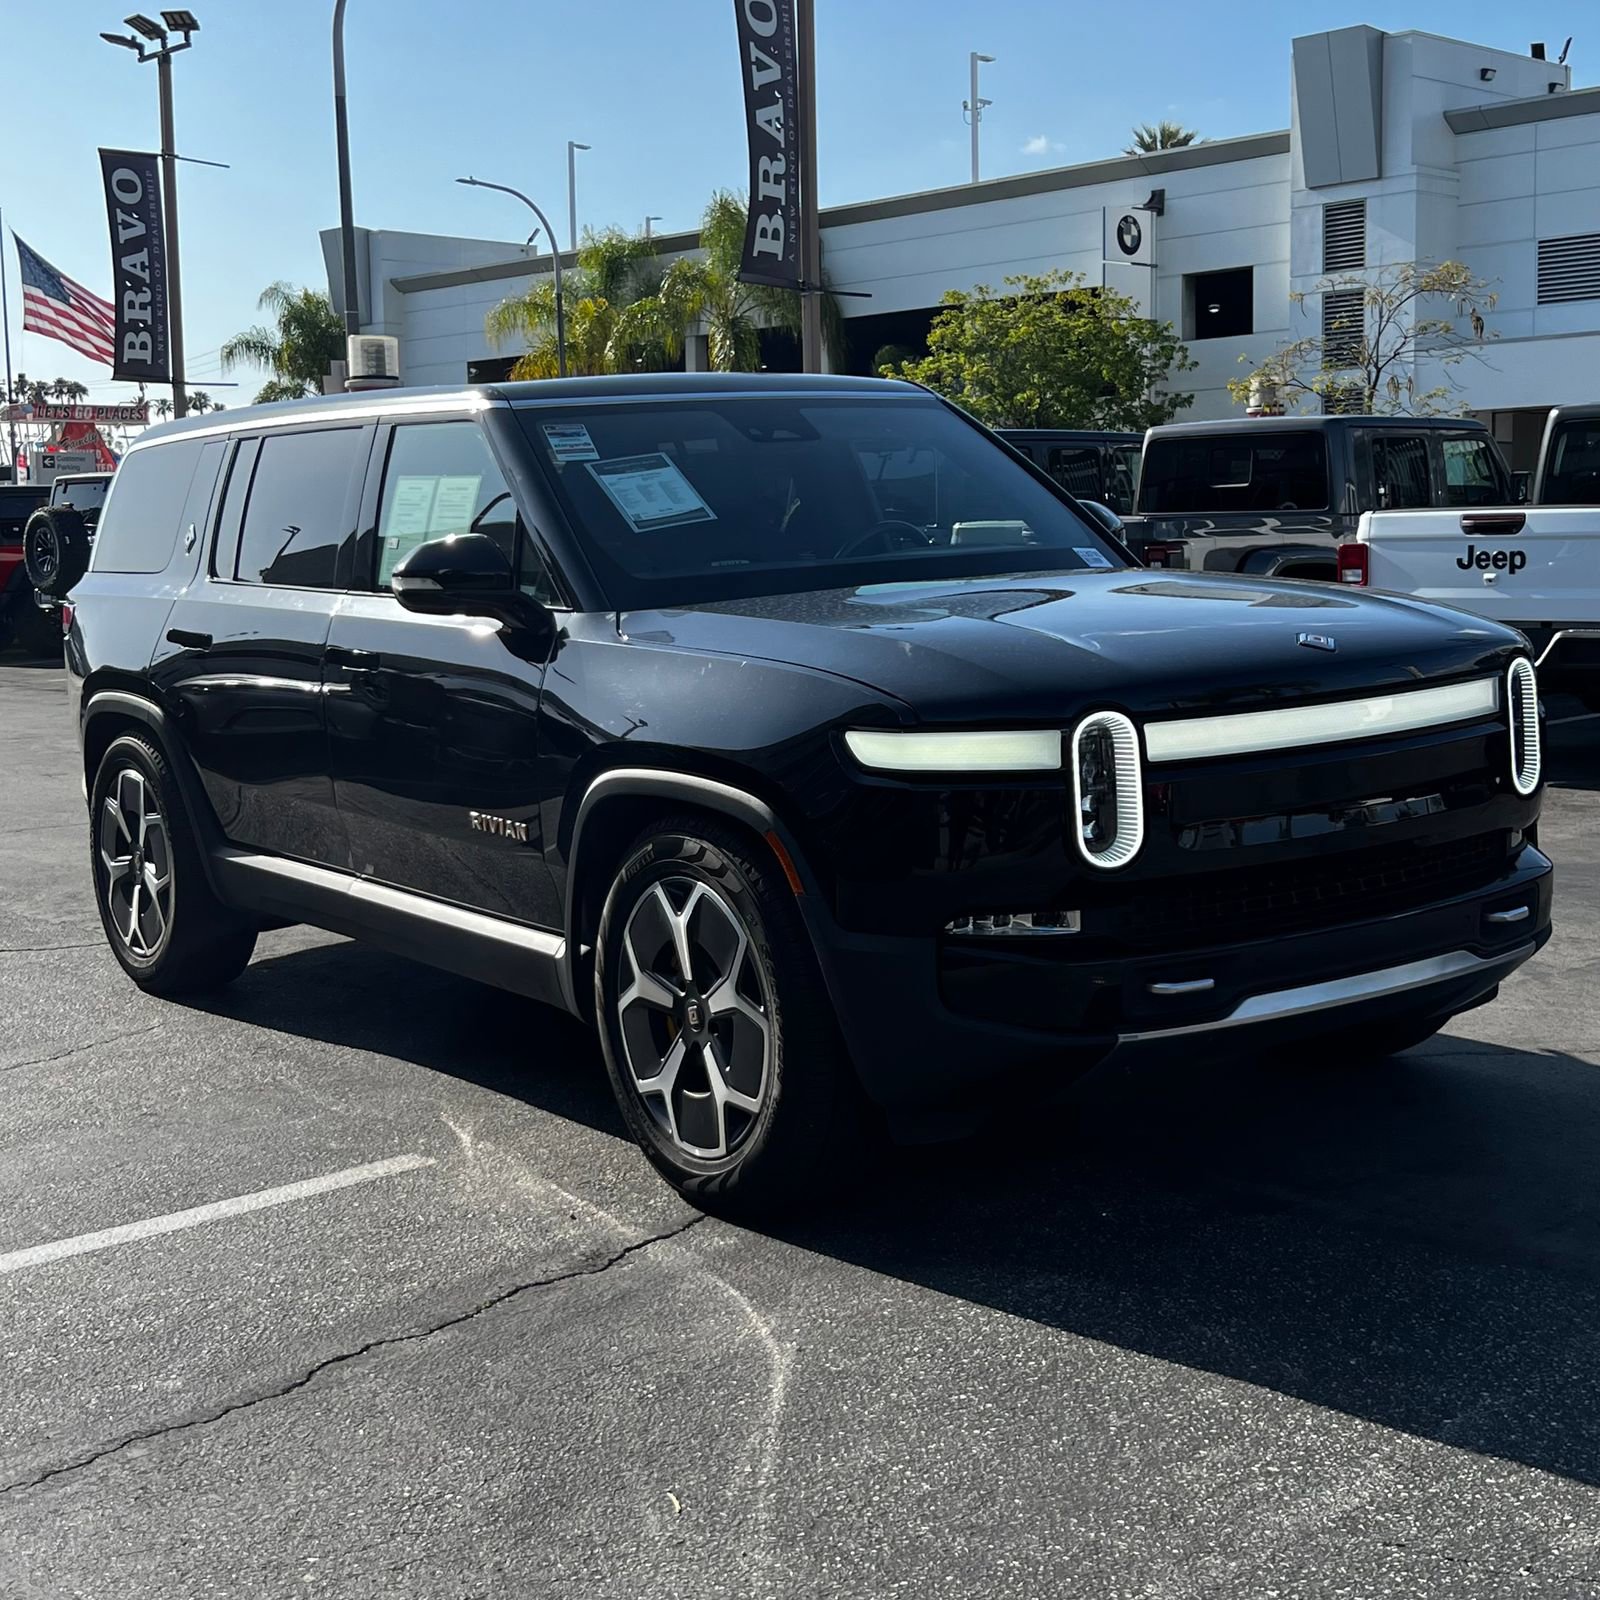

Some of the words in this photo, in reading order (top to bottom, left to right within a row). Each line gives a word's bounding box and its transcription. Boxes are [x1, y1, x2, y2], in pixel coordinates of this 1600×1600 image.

[781, 4, 795, 109] DEALERSHI
[744, 0, 787, 261] BRAVO
[788, 117, 795, 141] OF
[146, 170, 160, 254] DEALERSHIP
[111, 168, 152, 365] BRAVO
[154, 260, 162, 278] OF
[788, 253, 795, 262] A
[155, 284, 163, 316] KIND
[157, 323, 165, 352] NEW
[38, 405, 71, 419] LET'S
[75, 406, 93, 420] GO
[96, 407, 145, 420] PLACES
[57, 464, 81, 472] Parking
[1456, 544, 1527, 575] Jeep
[469, 811, 527, 842] RIVIAN
